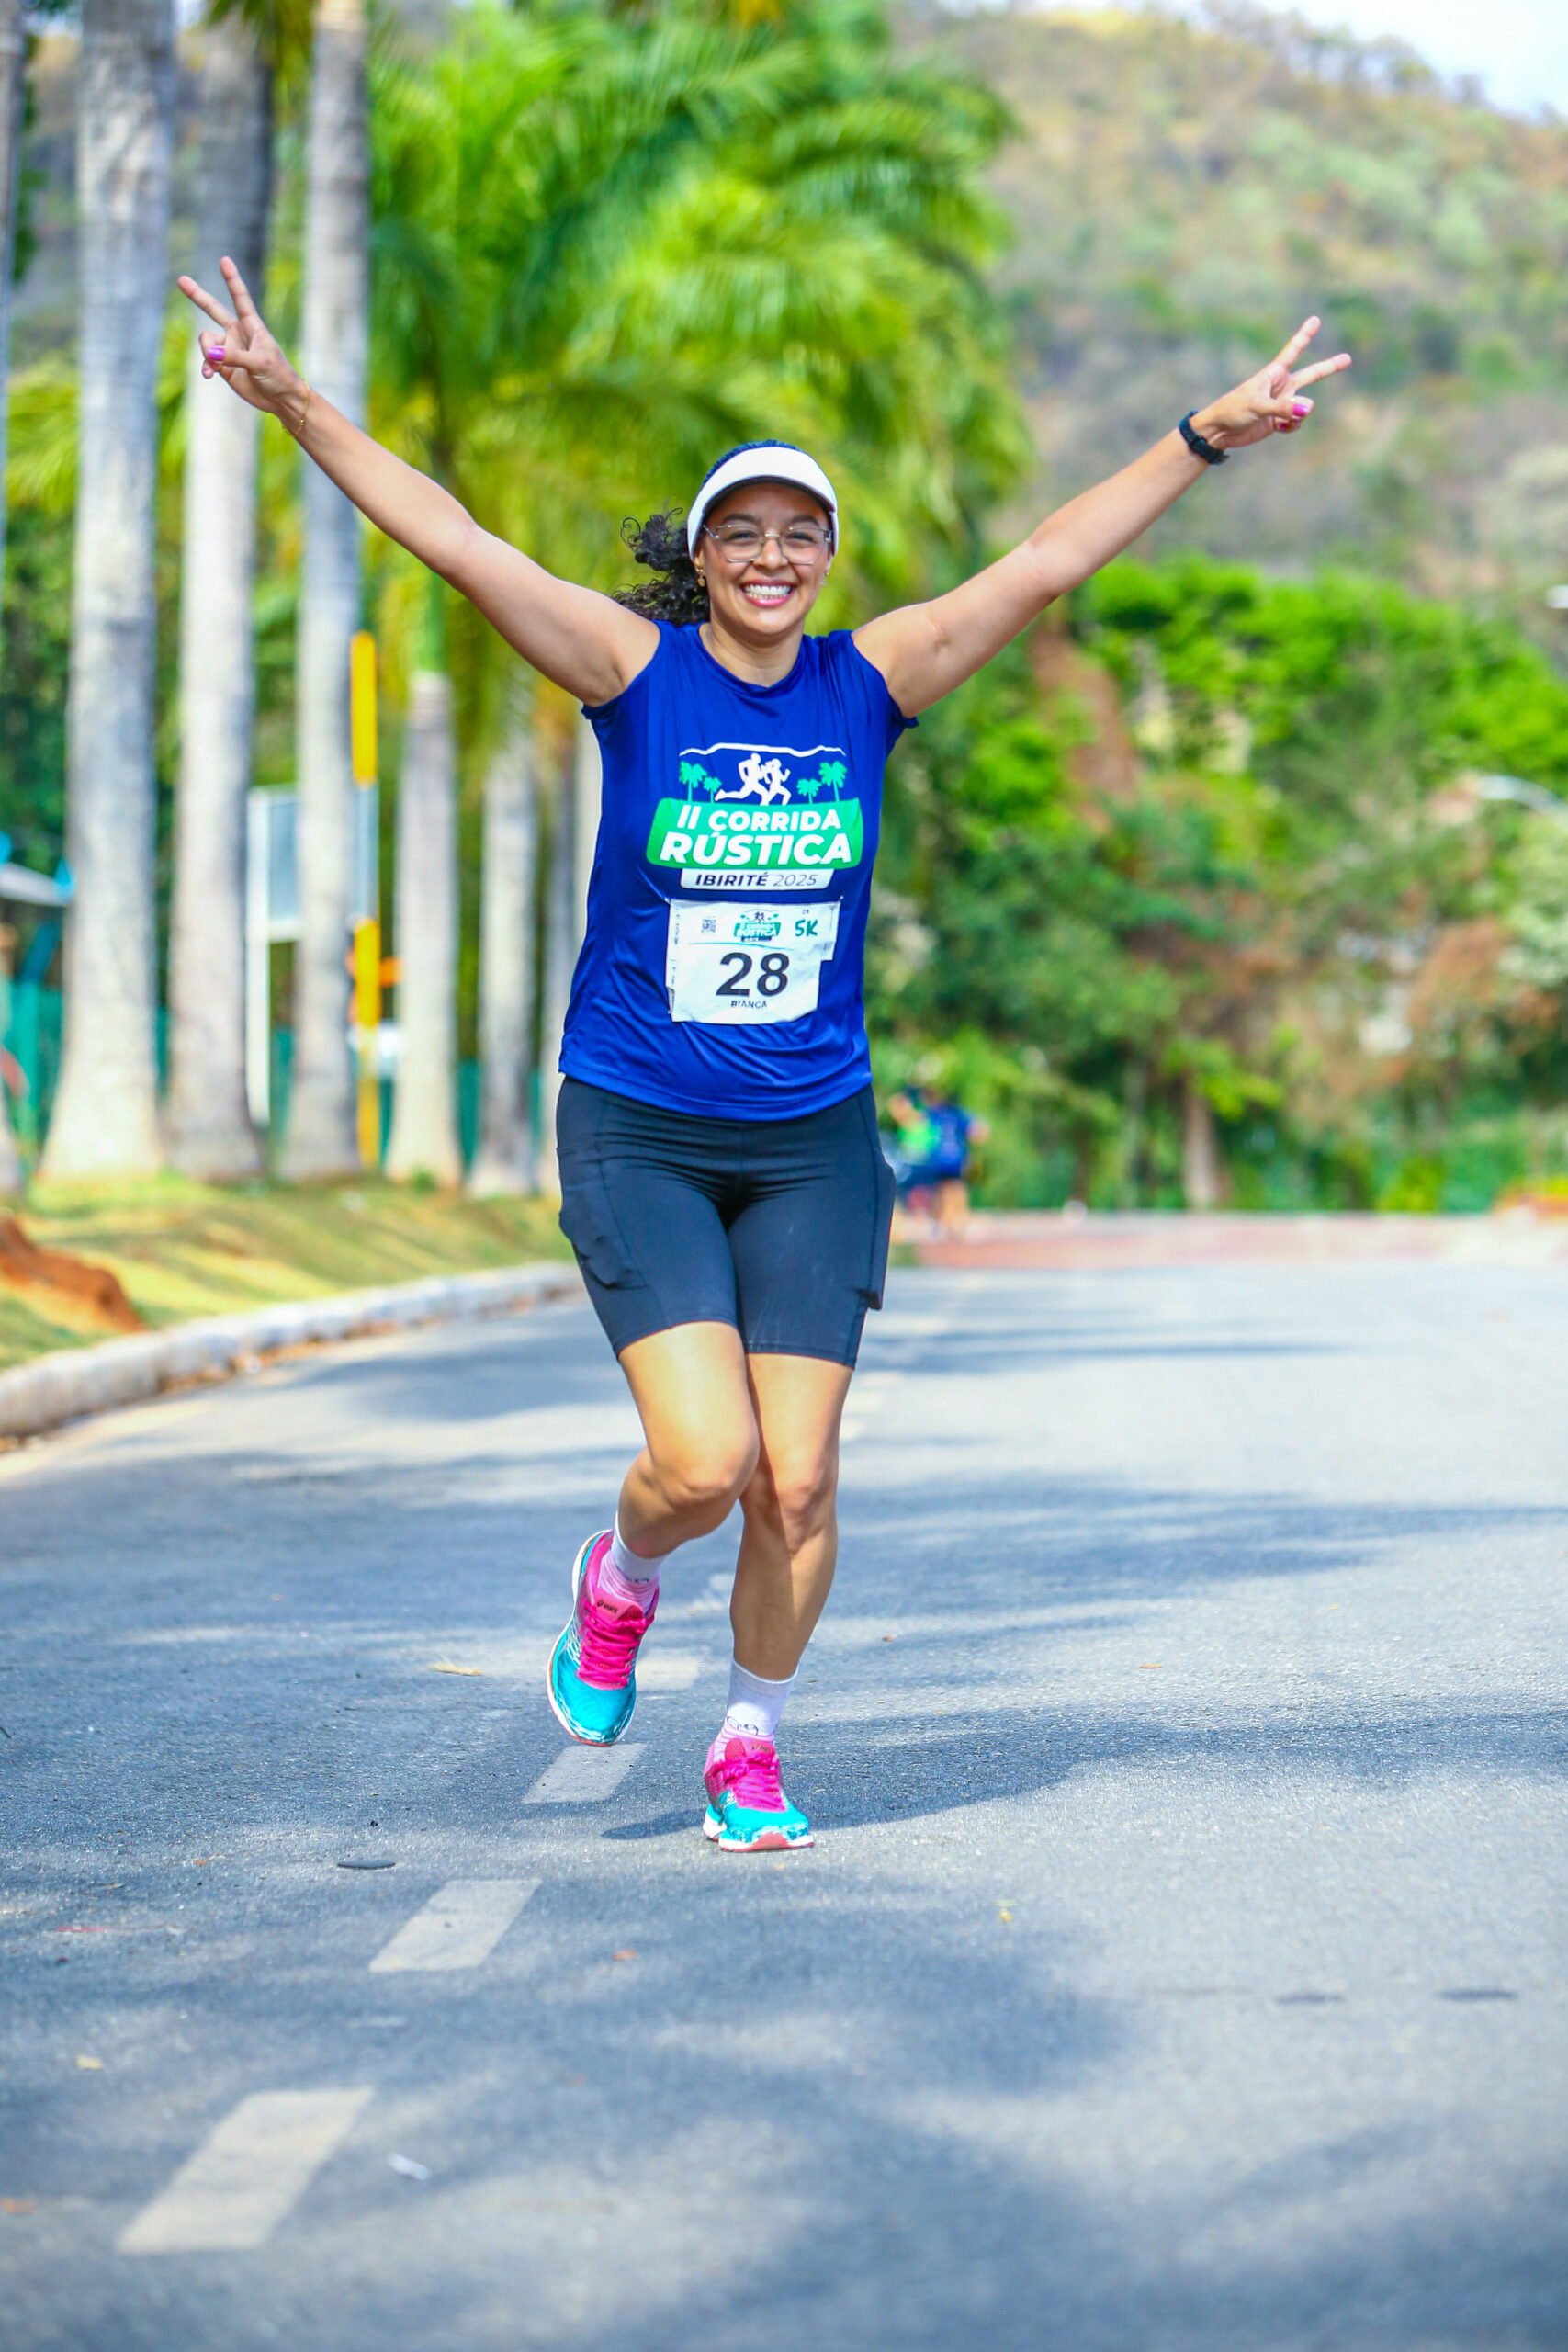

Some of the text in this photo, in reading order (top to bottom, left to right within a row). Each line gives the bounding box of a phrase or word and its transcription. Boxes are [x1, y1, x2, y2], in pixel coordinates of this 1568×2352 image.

[676, 805, 841, 831] II CORRIDA
[659, 831, 852, 865] RÚSTICA
[694, 871, 817, 887] IBIRITÉ 2025
[795, 919, 818, 937] 5K
[715, 952, 790, 997] 28
